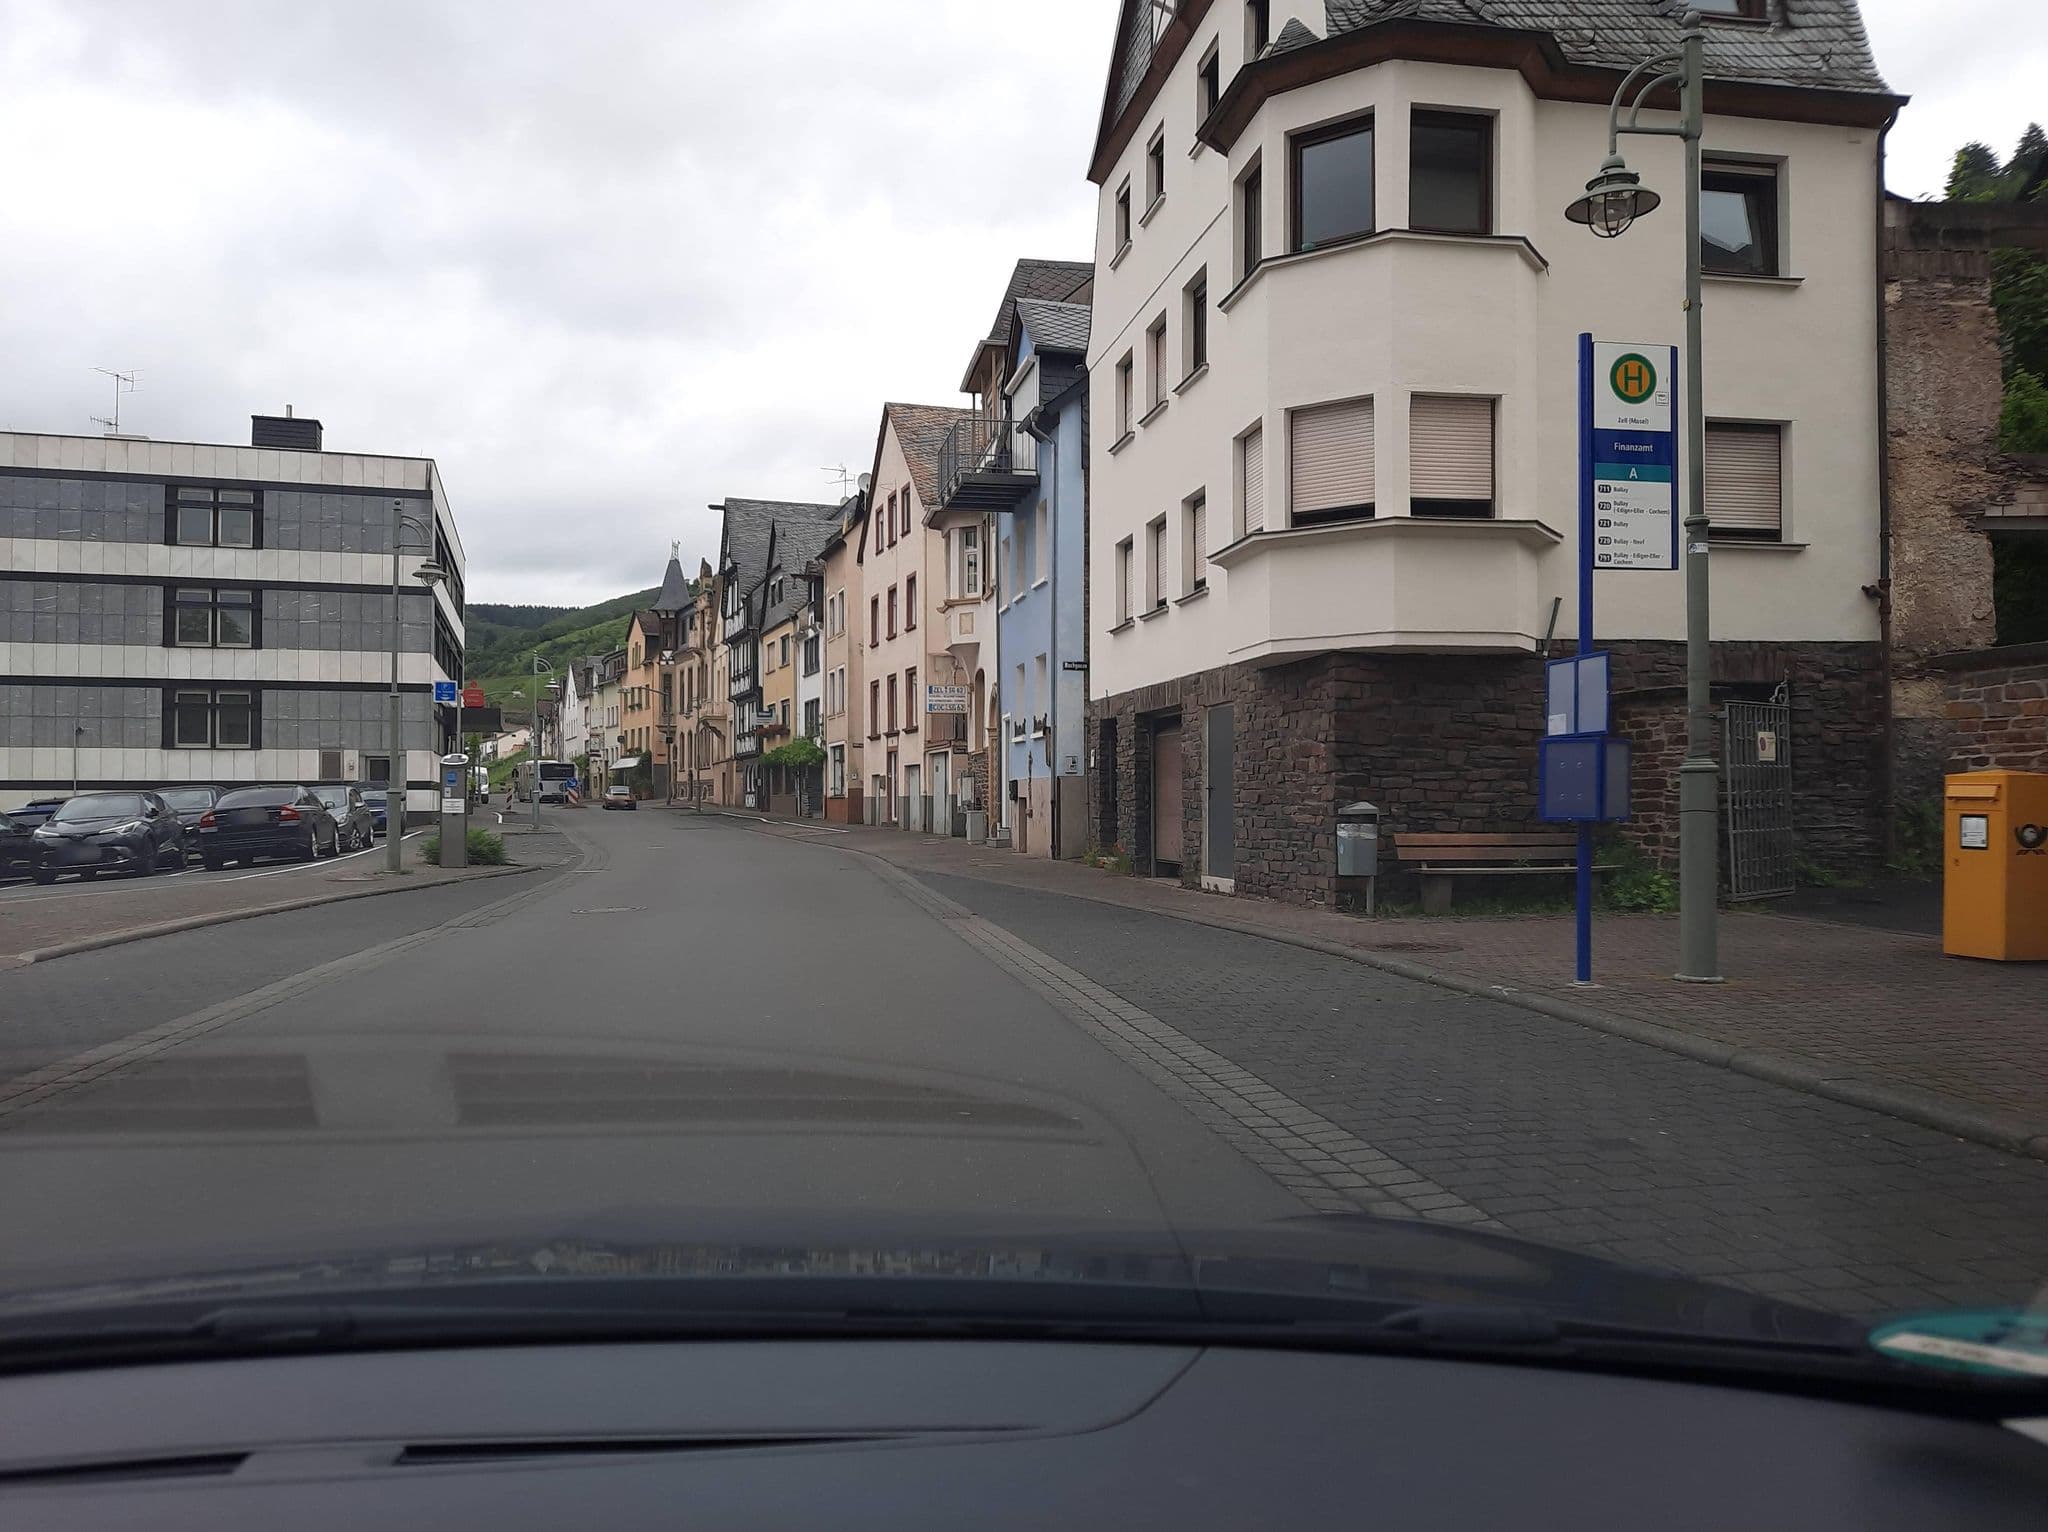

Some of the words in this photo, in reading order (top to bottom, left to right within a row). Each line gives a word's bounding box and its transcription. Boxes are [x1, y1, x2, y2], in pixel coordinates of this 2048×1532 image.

[1623, 364, 1643, 392] H
[1614, 442, 1654, 453] Finanzamt
[1629, 467, 1638, 480] A
